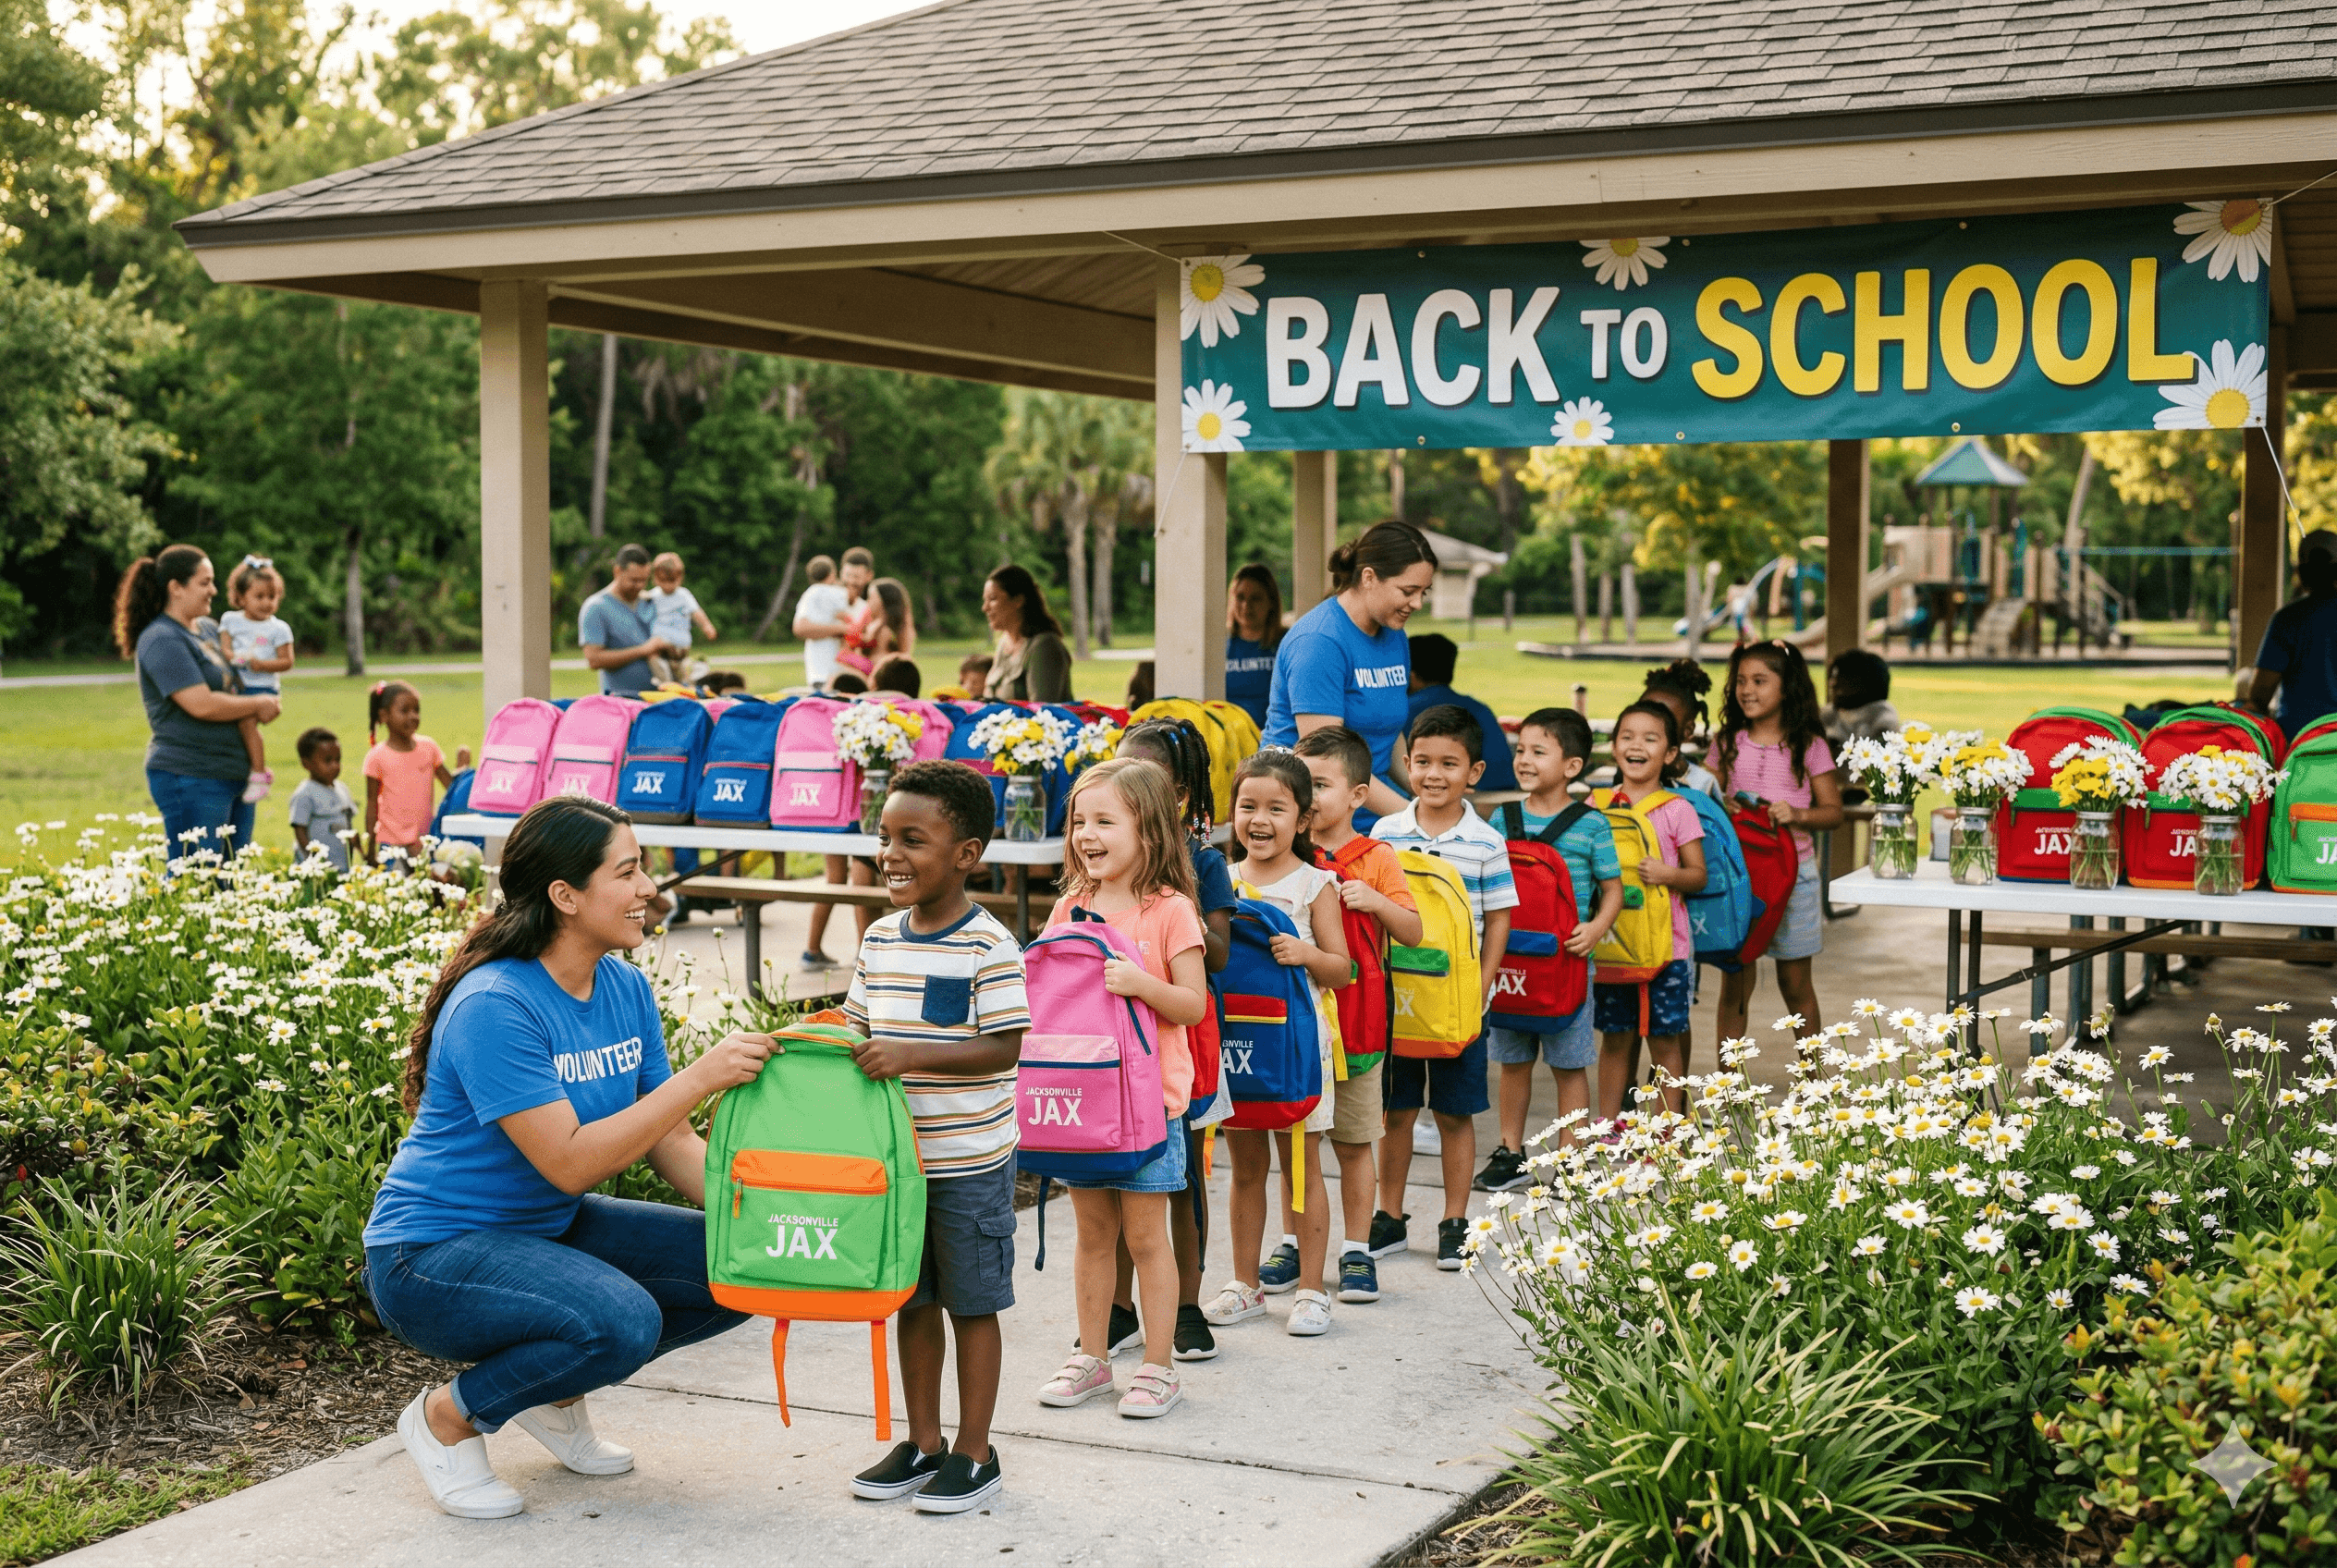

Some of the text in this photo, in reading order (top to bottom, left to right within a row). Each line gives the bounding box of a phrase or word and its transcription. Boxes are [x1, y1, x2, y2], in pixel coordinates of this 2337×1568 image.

[1266, 257, 2195, 409] BACK TO SCHOOL
[631, 777, 665, 794] JAX
[713, 783, 746, 802] JAX
[789, 788, 820, 806] JAX
[2170, 835, 2197, 857] JA
[1497, 974, 1527, 997] AX
[553, 1036, 642, 1084] VOLUNTEER
[1221, 1047, 1254, 1075] AX
[1025, 1086, 1083, 1096] JACKSONVILLE
[1027, 1096, 1083, 1126] JAX
[768, 1213, 838, 1227] JACKSONVILLE
[765, 1224, 838, 1260] JAX
